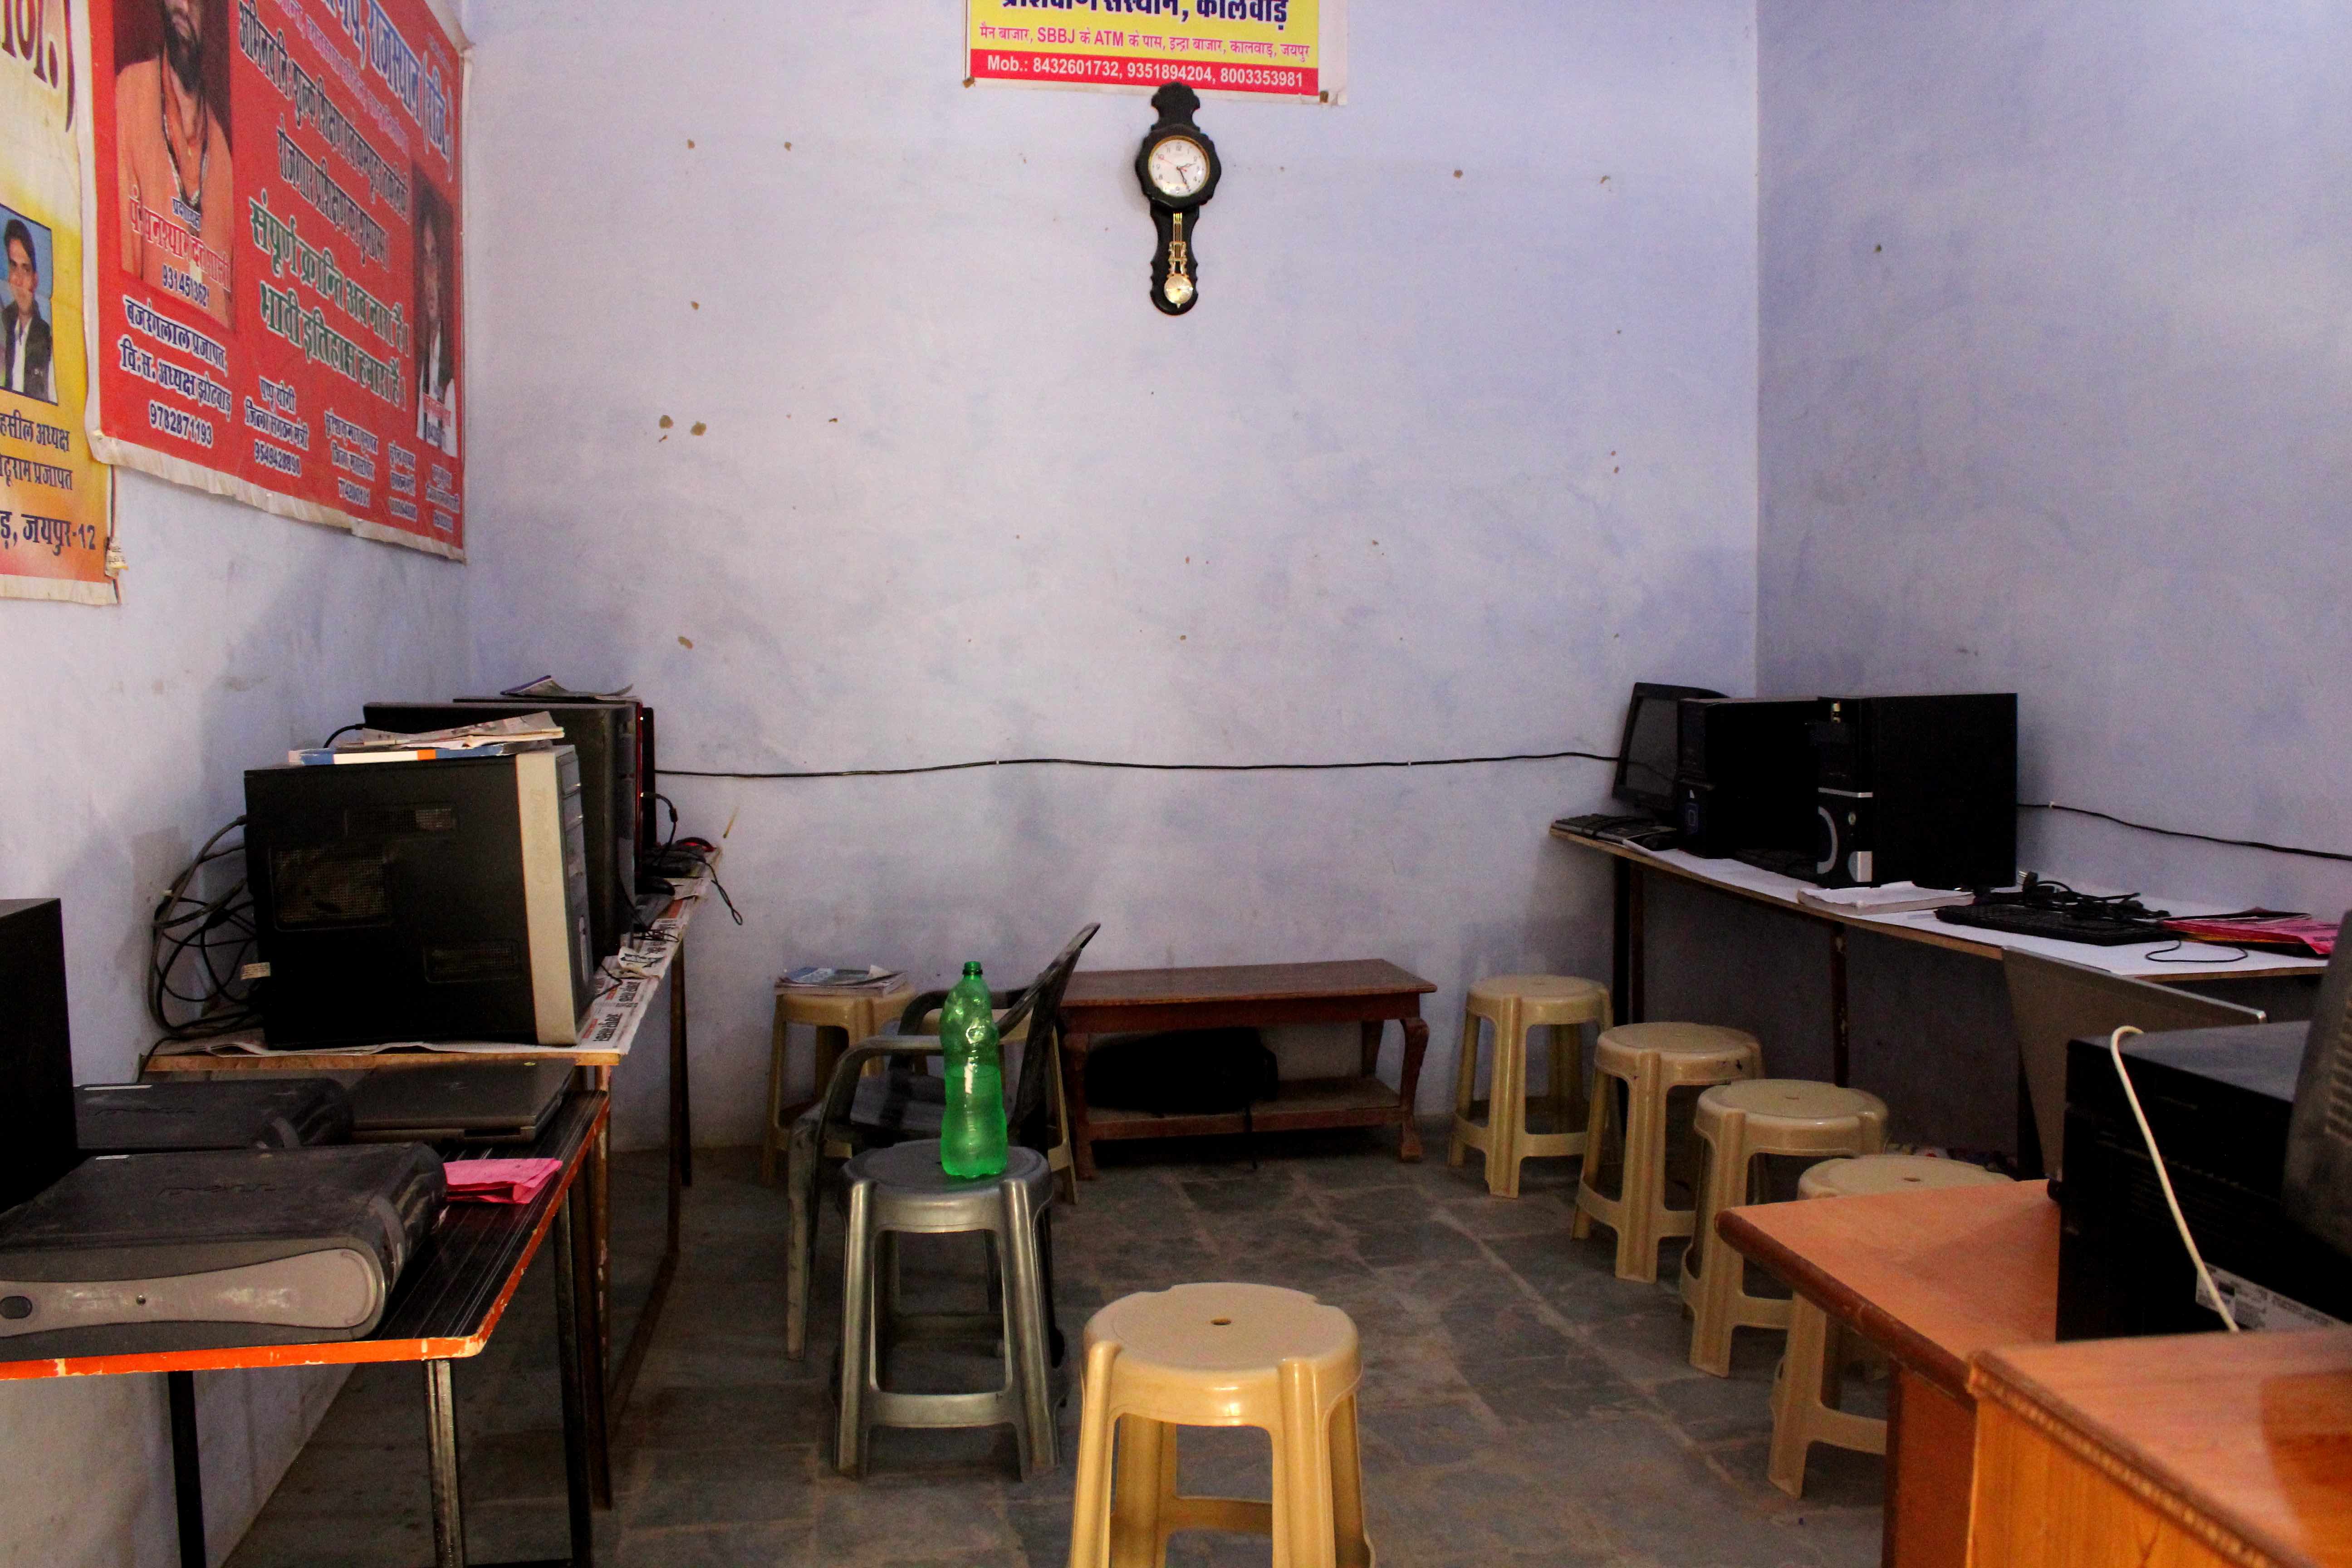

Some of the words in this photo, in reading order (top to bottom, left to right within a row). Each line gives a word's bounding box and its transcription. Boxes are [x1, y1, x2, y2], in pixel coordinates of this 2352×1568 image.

[980, 22, 996, 39] मैन
[998, 27, 1033, 44] बाजार,
[1038, 26, 1075, 44] SBBJ
[1079, 27, 1091, 44] के
[1094, 30, 1124, 46] ATM
[1128, 30, 1140, 47] के
[1142, 35, 1166, 51] पास,
[1193, 38, 1226, 54] बाजार,
[1280, 44, 1310, 63] जयपुर
[987, 54, 1028, 72] Mob.:
[1033, 58, 1123, 79] 8432601732,
[1127, 62, 1216, 84] 9351894204,
[1220, 68, 1303, 87] 8003353981
[124, 296, 190, 350] बजरंगलाल
[158, 362, 196, 397] अध्यक्ष
[0, 409, 34, 442] हसील
[36, 423, 70, 452] अध्यक्ष
[149, 402, 213, 448] 9782871193
[33, 461, 73, 490] प्रजापत
[21, 513, 96, 556] जयपुर-12
